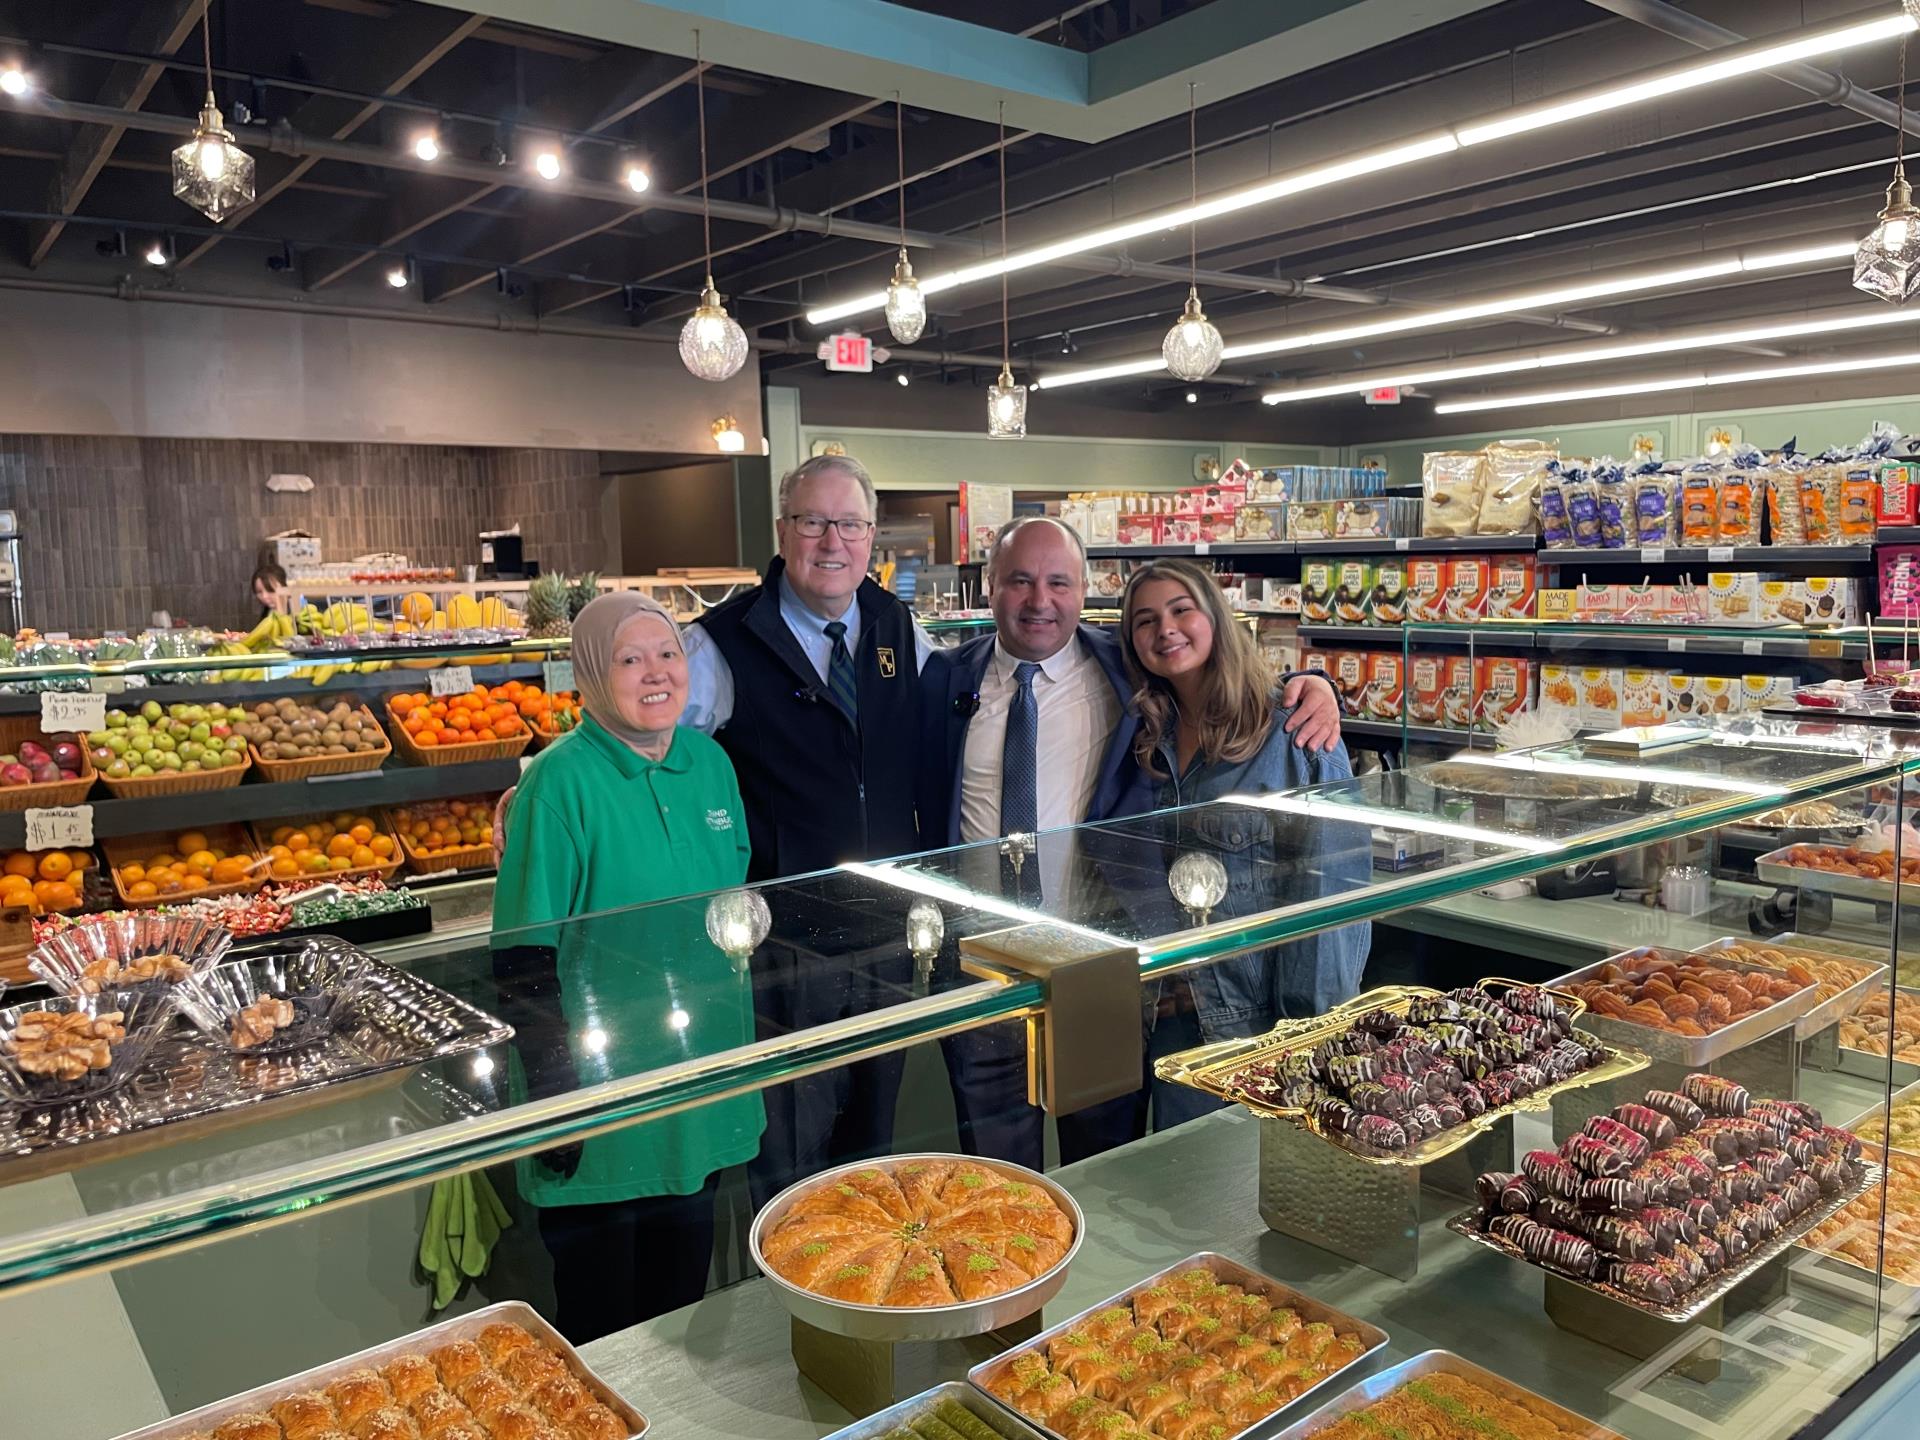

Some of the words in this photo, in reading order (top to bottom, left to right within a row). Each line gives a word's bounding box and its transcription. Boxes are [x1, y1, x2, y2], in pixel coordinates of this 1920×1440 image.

[836, 336, 866, 367] EXIT
[1892, 553, 1912, 605] UNREAL
[1545, 592, 1568, 600] MADE
